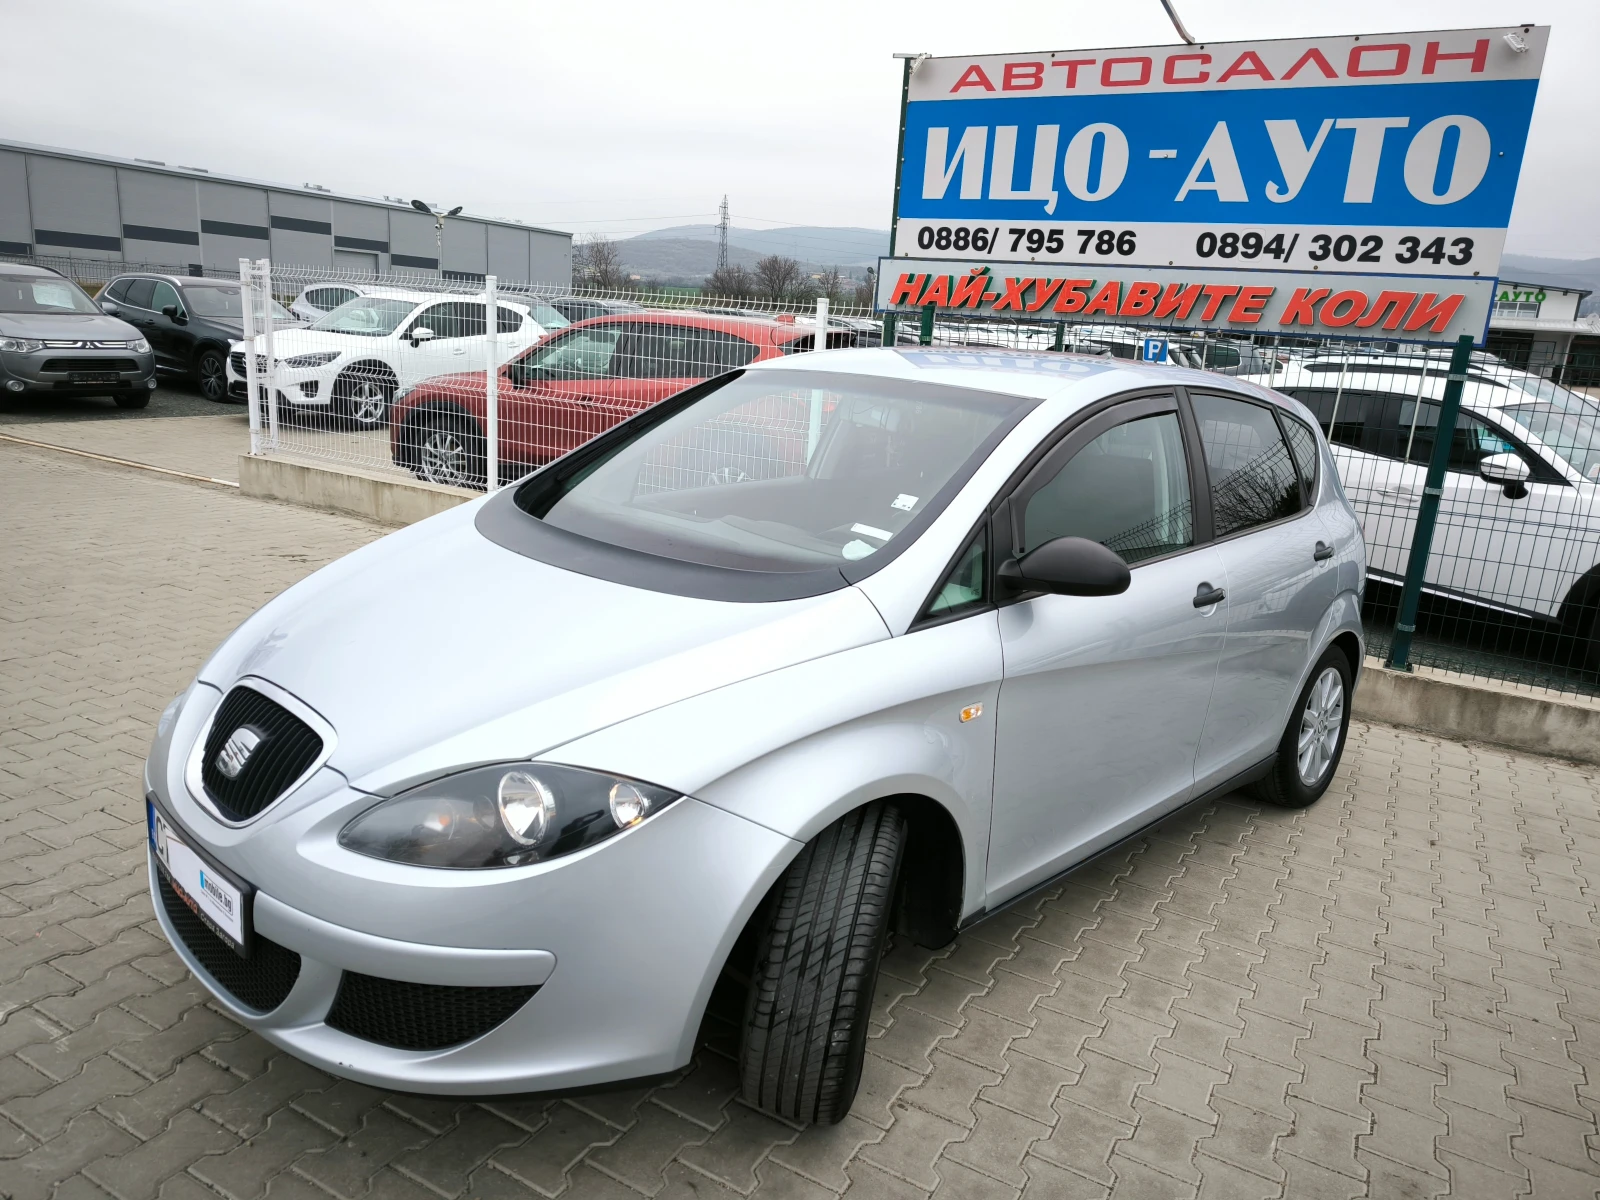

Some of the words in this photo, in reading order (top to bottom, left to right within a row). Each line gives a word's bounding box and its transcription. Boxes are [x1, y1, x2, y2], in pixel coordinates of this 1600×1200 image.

[949, 39, 1490, 93] АВТОСАЛОН
[917, 226, 999, 254] 0886/
[1008, 228, 1064, 253] 795
[1077, 229, 1137, 256] 786
[1196, 232, 1300, 263] 0894/
[1308, 234, 1384, 262] 302
[1395, 236, 1475, 265] 343
[889, 266, 1276, 323] НАЙ-ХУБАВИТЕ
[1279, 287, 1466, 333] КОЛИ
[1148, 341, 1162, 358] P
[203, 877, 232, 912] mobile.bg
